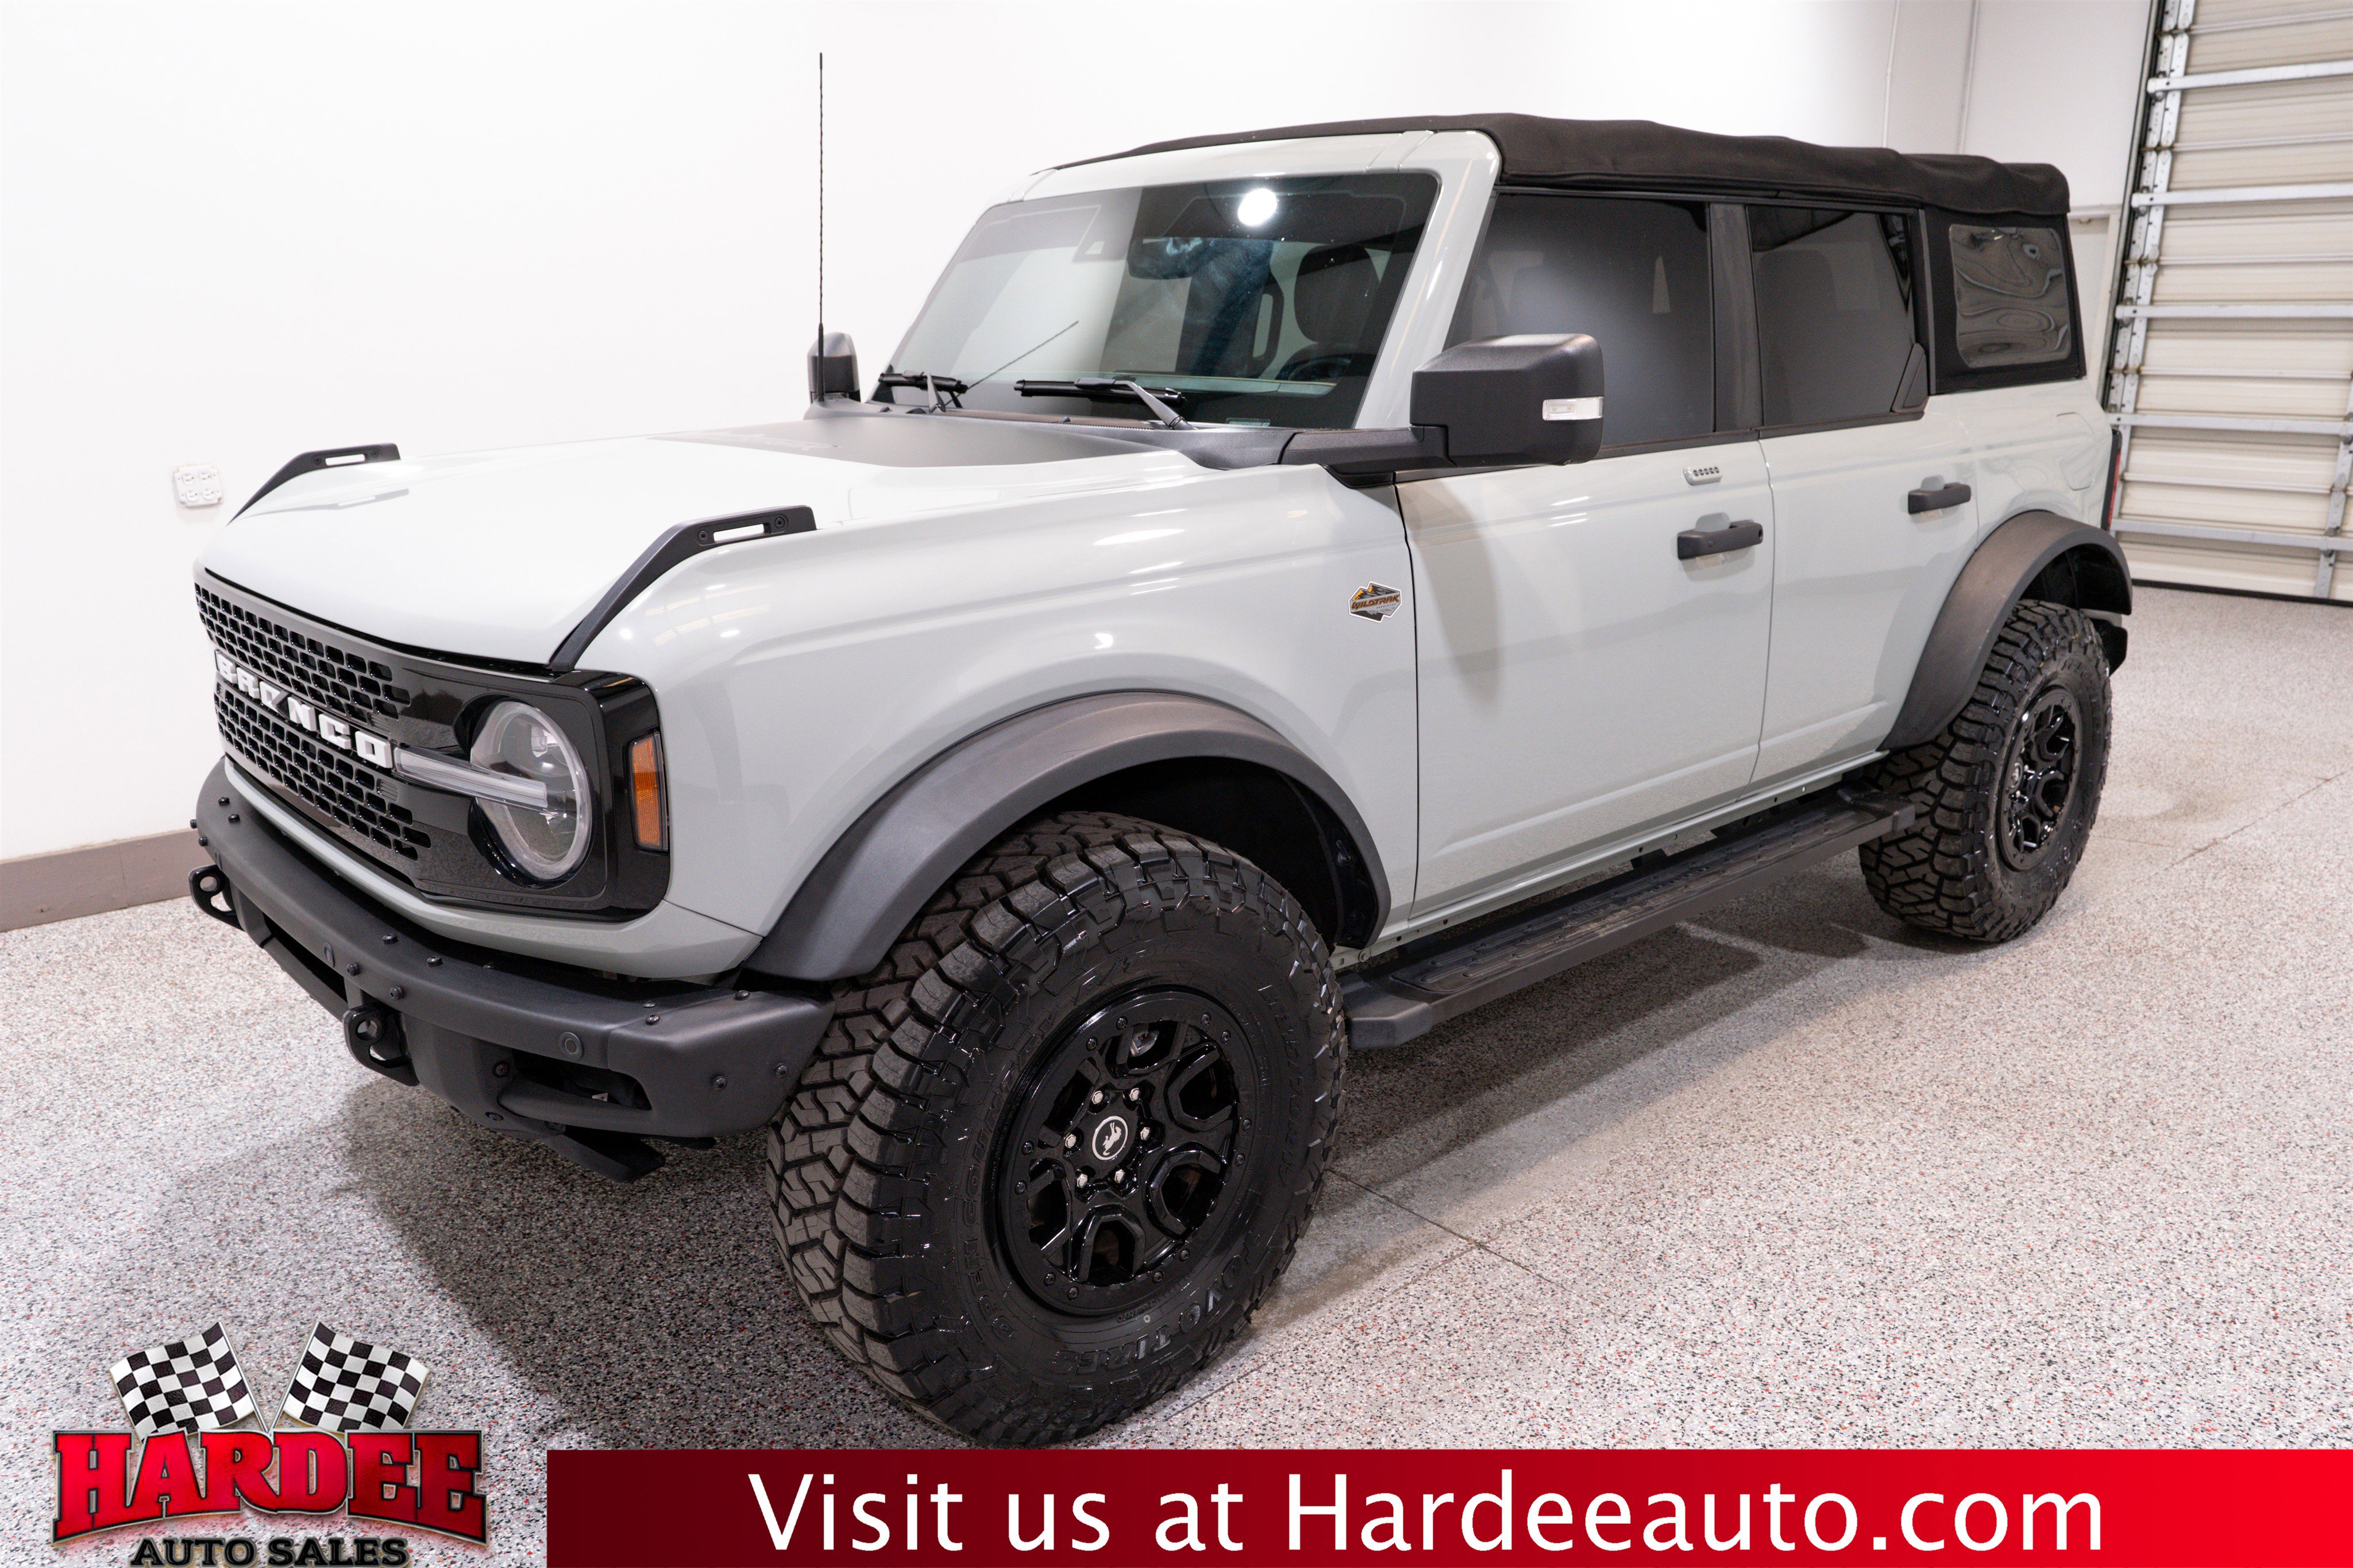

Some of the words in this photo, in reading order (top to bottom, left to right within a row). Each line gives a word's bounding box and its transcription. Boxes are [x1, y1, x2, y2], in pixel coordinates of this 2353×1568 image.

[1352, 594, 1399, 609] WILDTRAK
[217, 652, 395, 769] BRONCO
[963, 1238, 1015, 1341] OPEN
[1179, 1229, 1264, 1334] TOYO
[1052, 1323, 1172, 1374] TIRES
